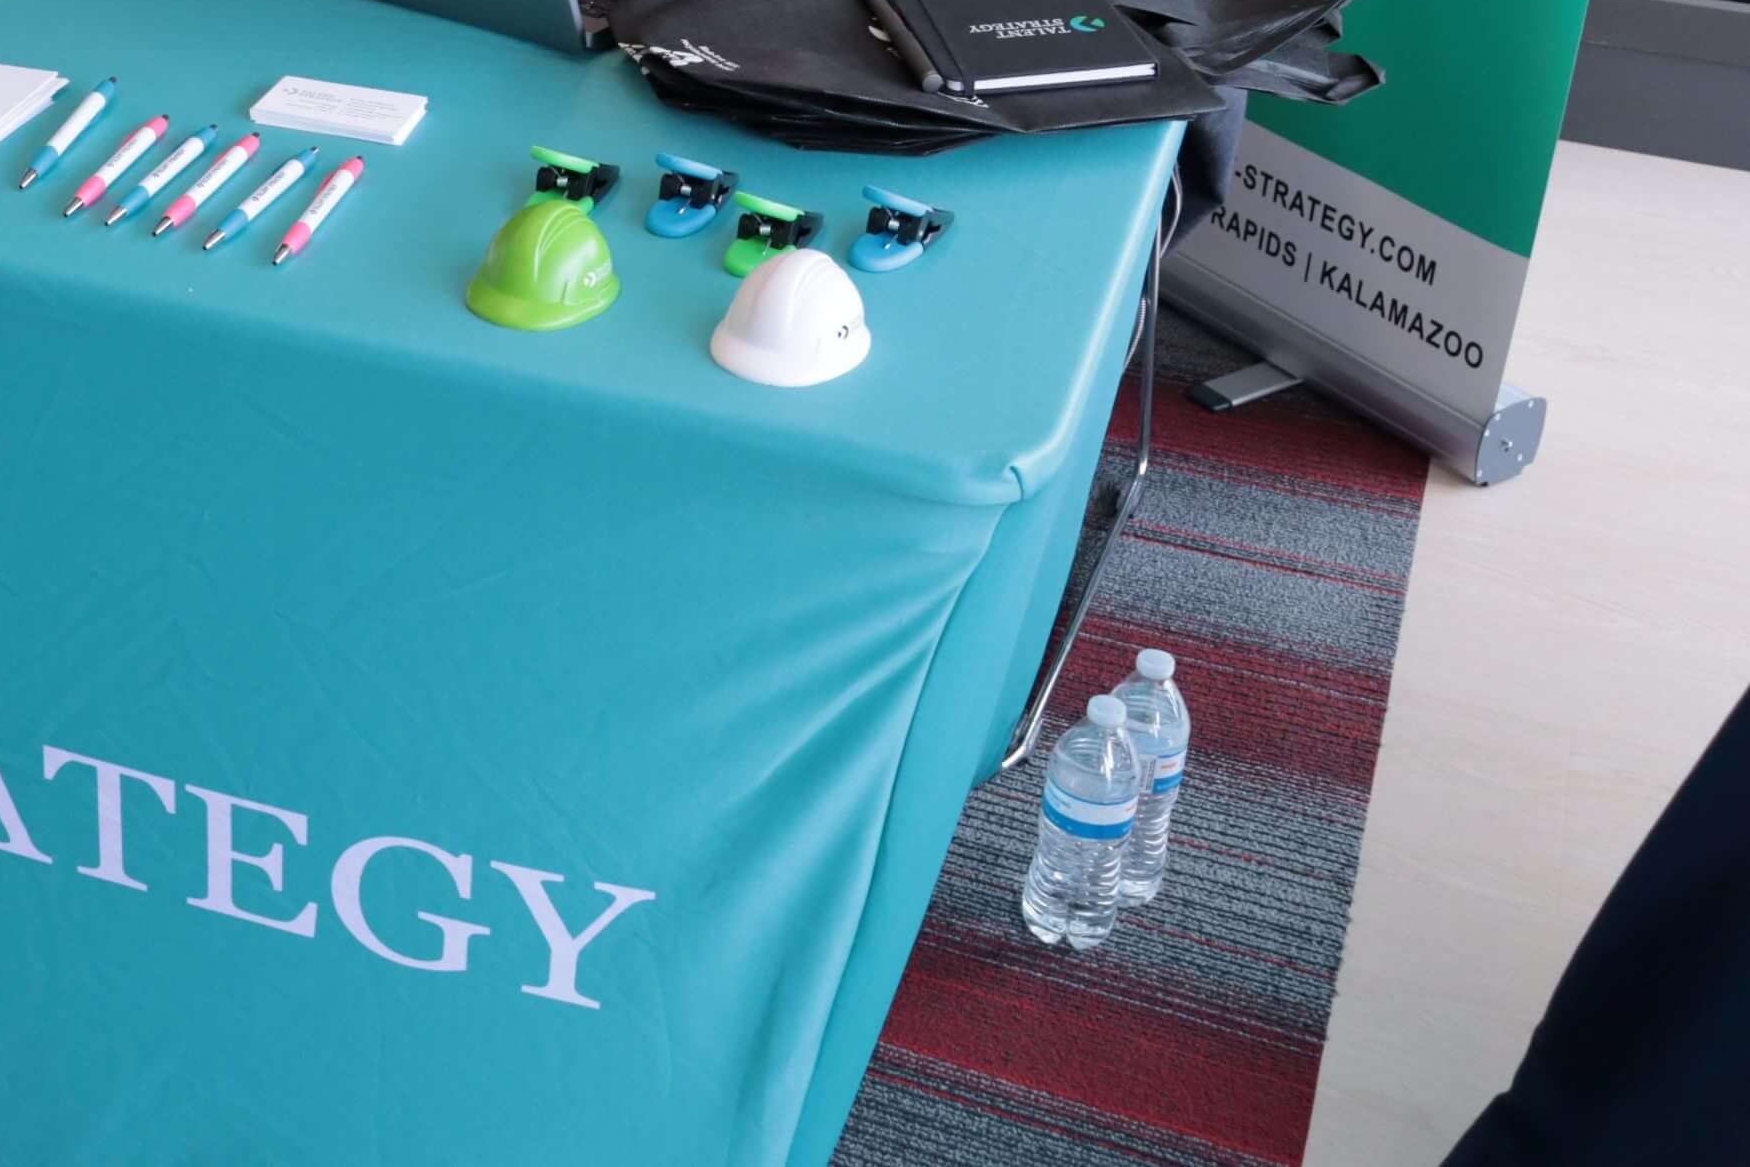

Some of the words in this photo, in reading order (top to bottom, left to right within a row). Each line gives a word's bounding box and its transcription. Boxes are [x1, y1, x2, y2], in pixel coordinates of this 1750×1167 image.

[969, 18, 1065, 34] STRATEGY
[996, 26, 1072, 40] TALENT
[1235, 163, 1438, 286] -STRATEGY.COM
[1210, 205, 1297, 267] RAPIDS
[1320, 260, 1484, 369] KALAMAZOO
